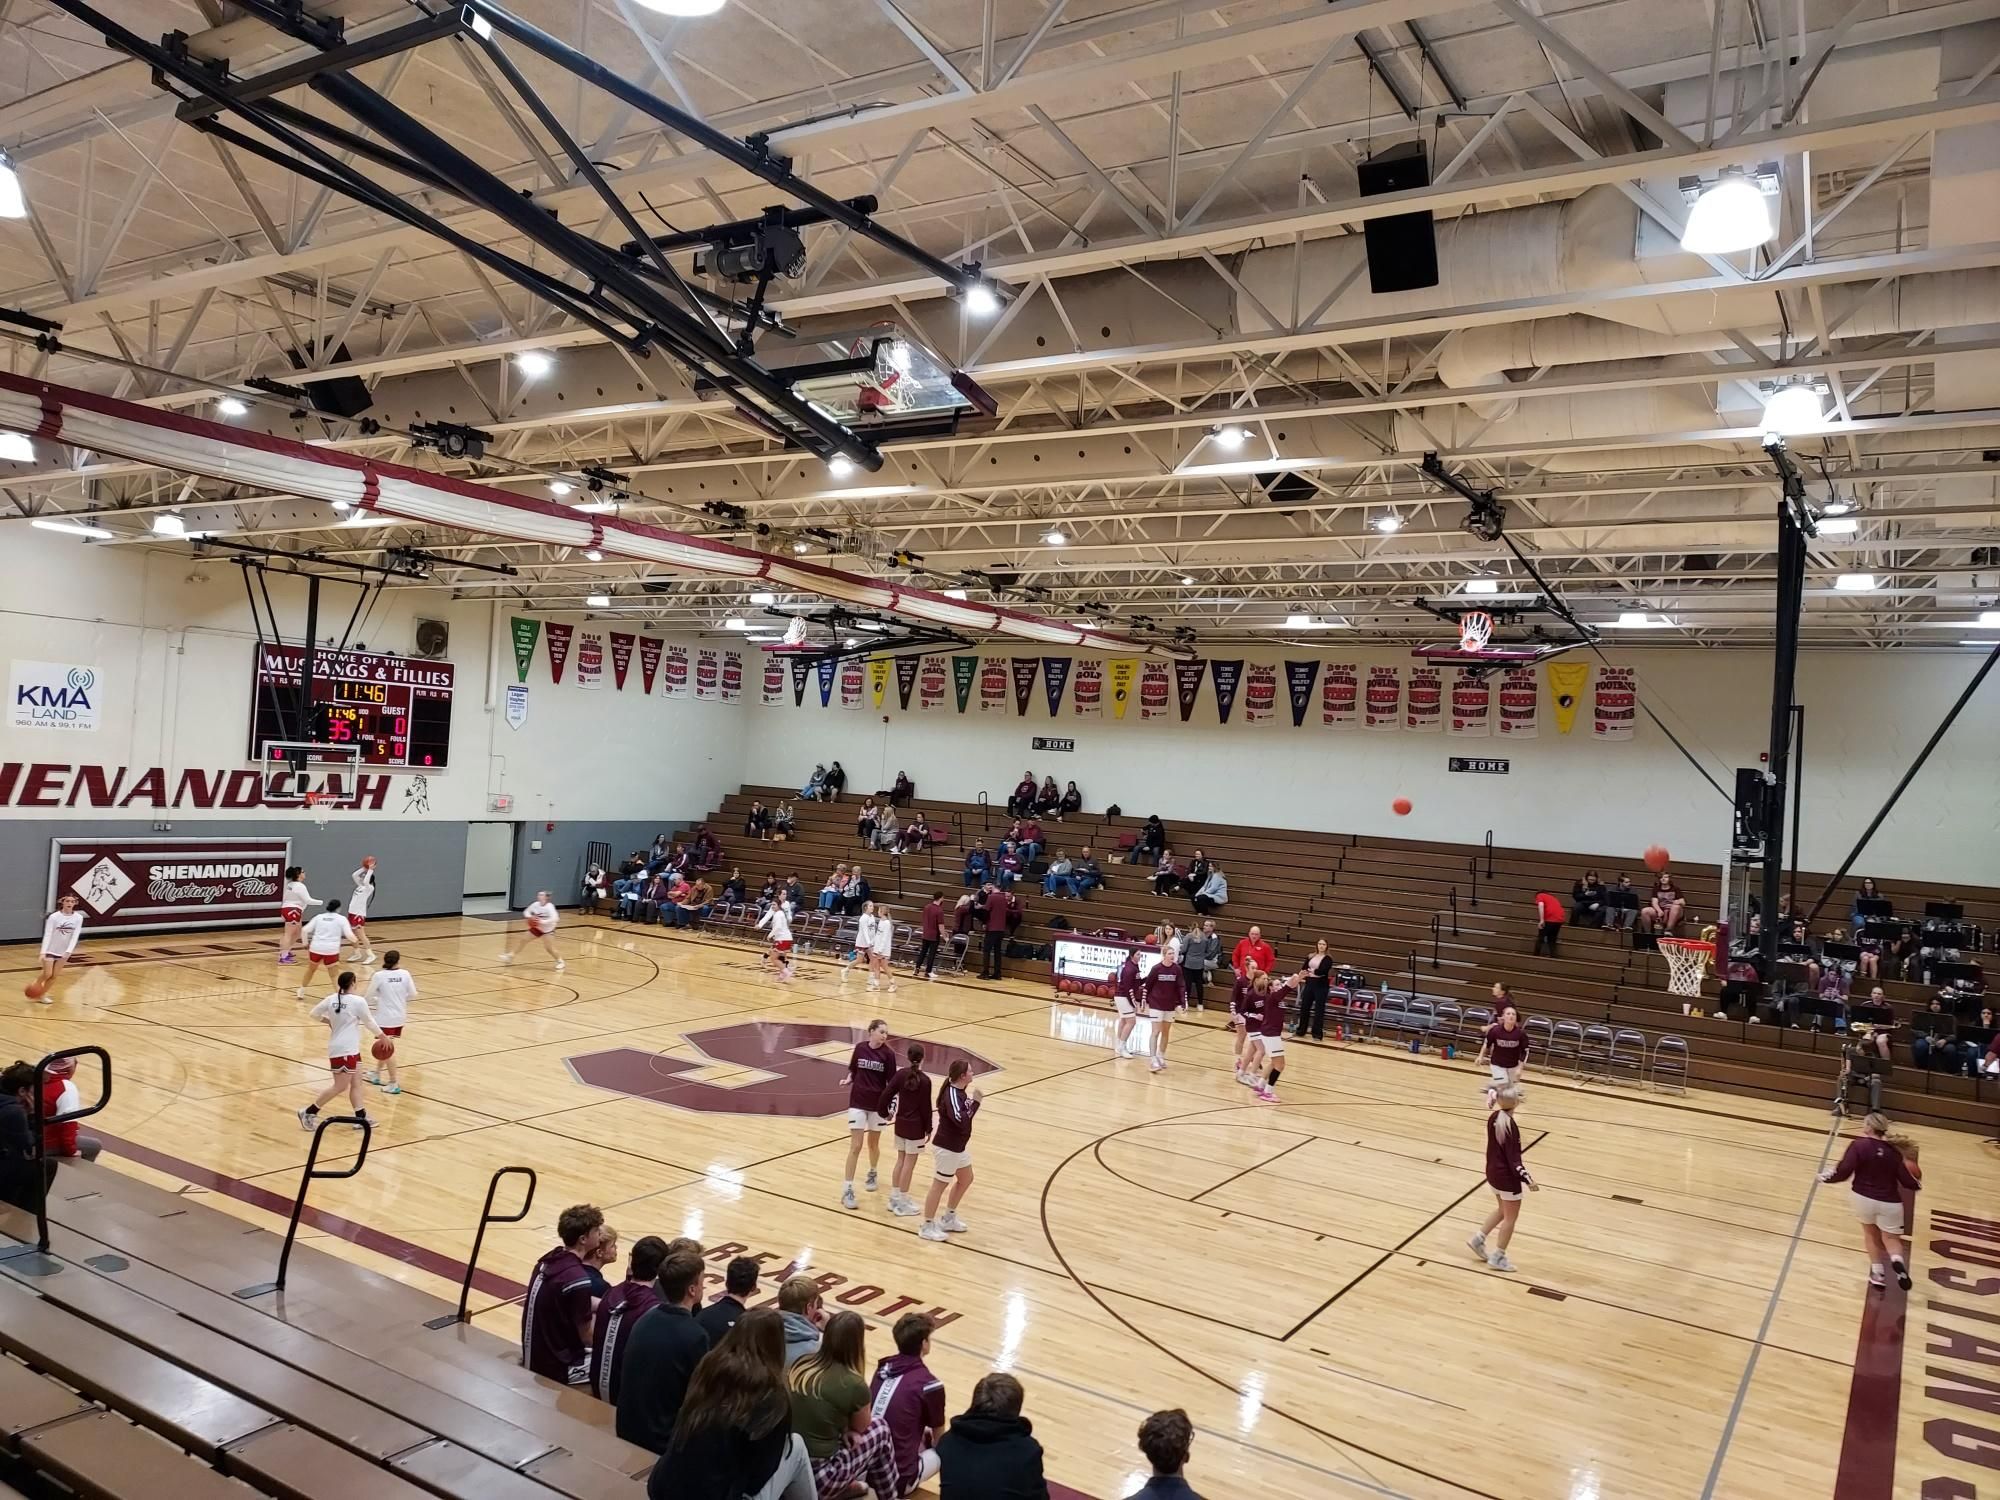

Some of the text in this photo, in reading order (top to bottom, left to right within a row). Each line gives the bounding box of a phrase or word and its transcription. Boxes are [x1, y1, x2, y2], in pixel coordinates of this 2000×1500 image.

[318, 652, 407, 668] HOME OF THE
[375, 667, 387, 680] &
[394, 668, 450, 685] FILLIES
[1324, 676, 1357, 686] BOWLING
[1367, 679, 1400, 689] BOWLING
[1408, 680, 1442, 689] TENNIS
[1453, 681, 1489, 690] BOWLING
[1500, 681, 1537, 691] BOWLING
[17, 684, 91, 710] KMA
[343, 683, 385, 702] 11:46
[32, 708, 77, 720] LAND
[328, 708, 356, 721] 11:46
[382, 706, 406, 716] GUEST
[328, 719, 351, 740] 35
[1046, 740, 1072, 749] HOME
[1468, 762, 1505, 771] HOME
[149, 864, 279, 880] SHENANDOAH
[148, 878, 278, 903] Mustangs Fillies
[1081, 946, 1148, 968] SHENANDH
